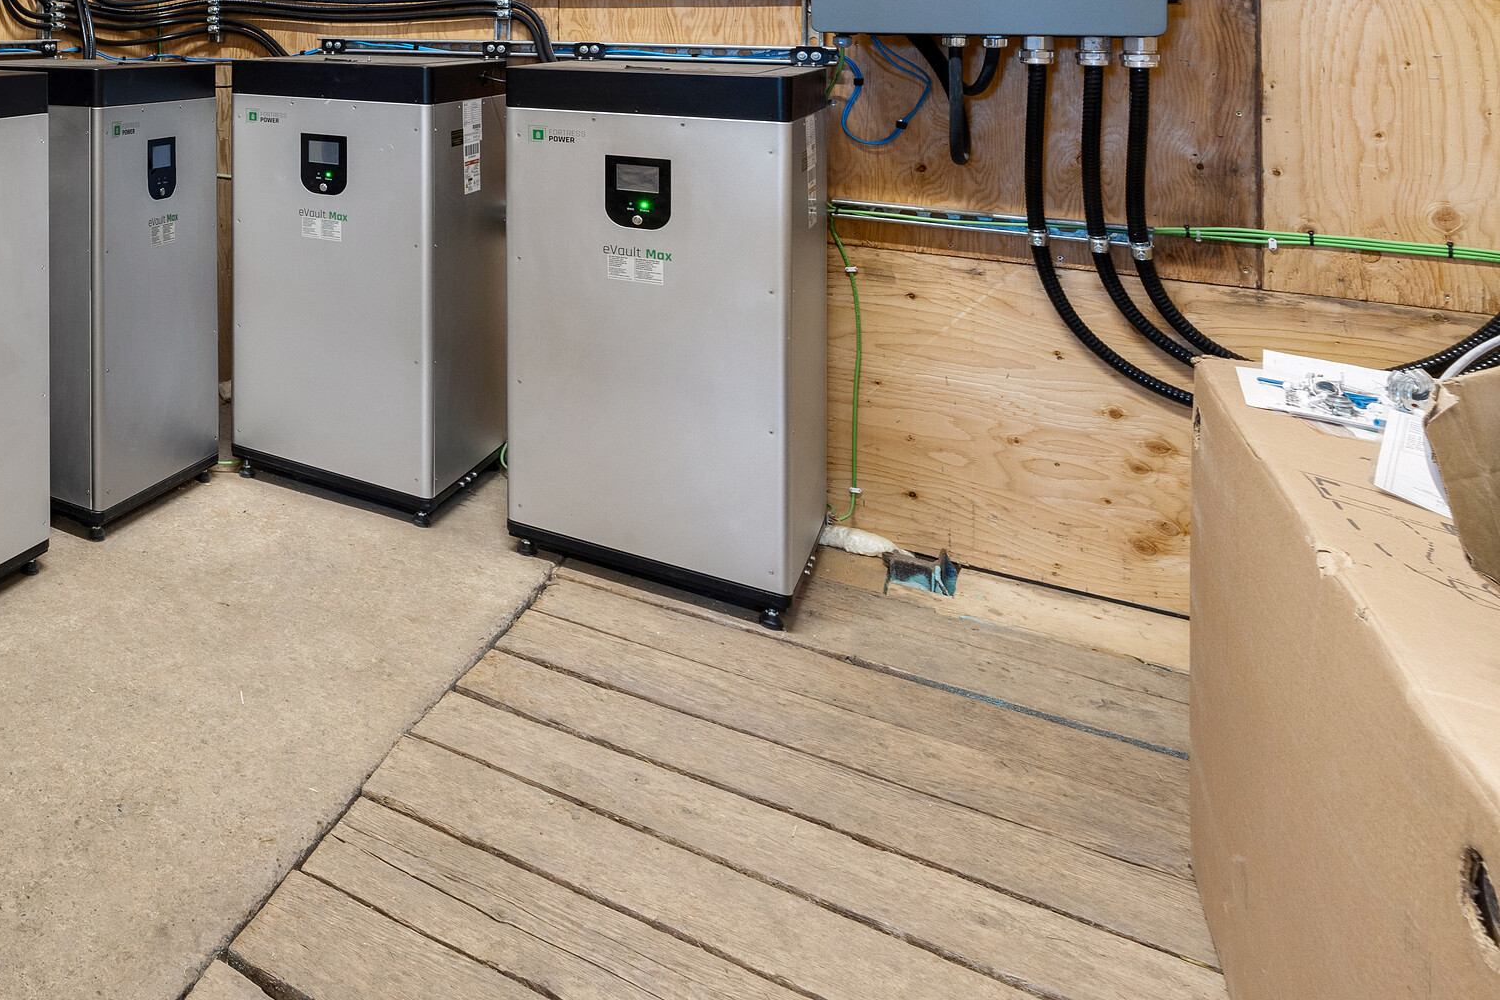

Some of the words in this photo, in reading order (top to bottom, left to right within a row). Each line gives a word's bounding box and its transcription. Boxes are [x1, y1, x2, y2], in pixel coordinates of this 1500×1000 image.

[548, 129, 586, 138] FORTRESS
[548, 135, 575, 143] POWER
[298, 208, 326, 219] eVault
[328, 211, 348, 222] Max
[602, 245, 641, 258] eVault
[645, 248, 673, 262] Max
